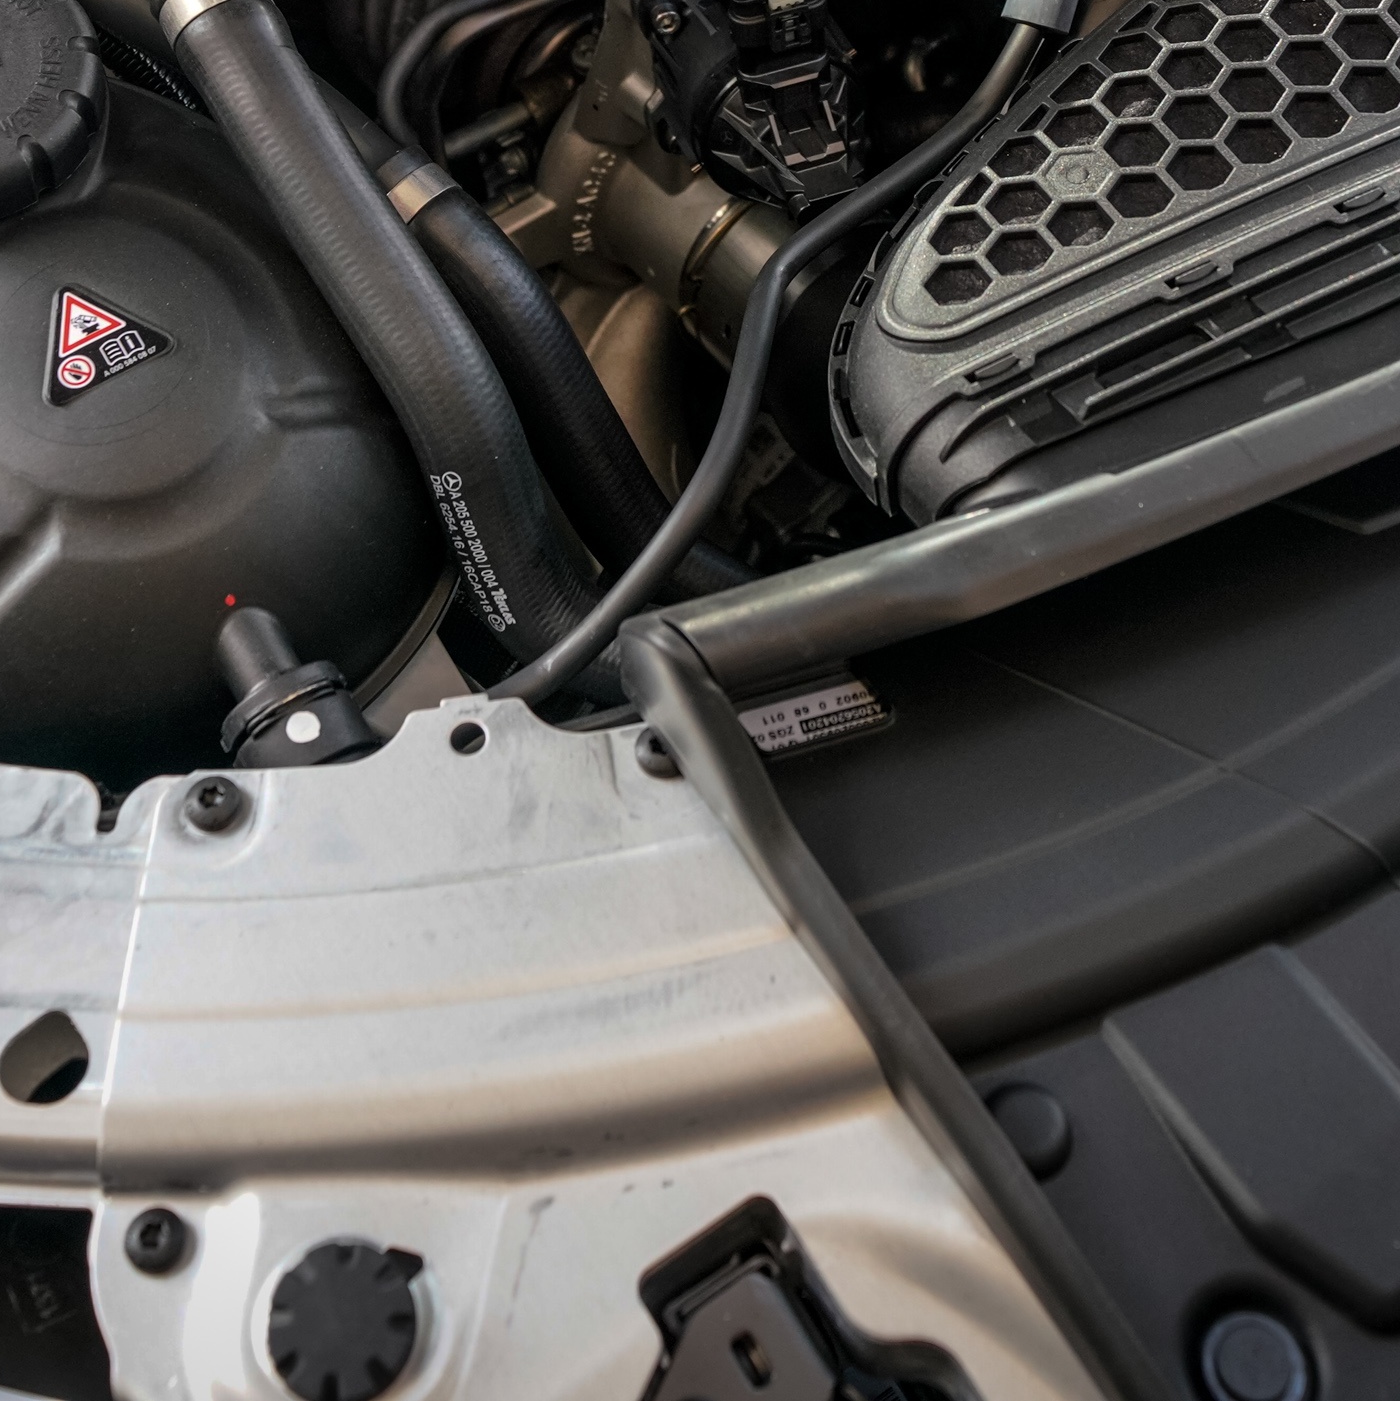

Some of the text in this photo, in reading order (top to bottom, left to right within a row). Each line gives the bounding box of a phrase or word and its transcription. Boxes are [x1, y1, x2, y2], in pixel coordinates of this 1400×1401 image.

[35, 36, 62, 88] HEISS
[109, 363, 124, 374] 000
[452, 500, 470, 519] 205
[460, 519, 478, 538] 500
[430, 474, 445, 499] DBL
[462, 560, 493, 613] 16CAP18
[467, 538, 488, 563] 2000
[481, 569, 499, 588] 004
[491, 588, 516, 625] TEKLAS
